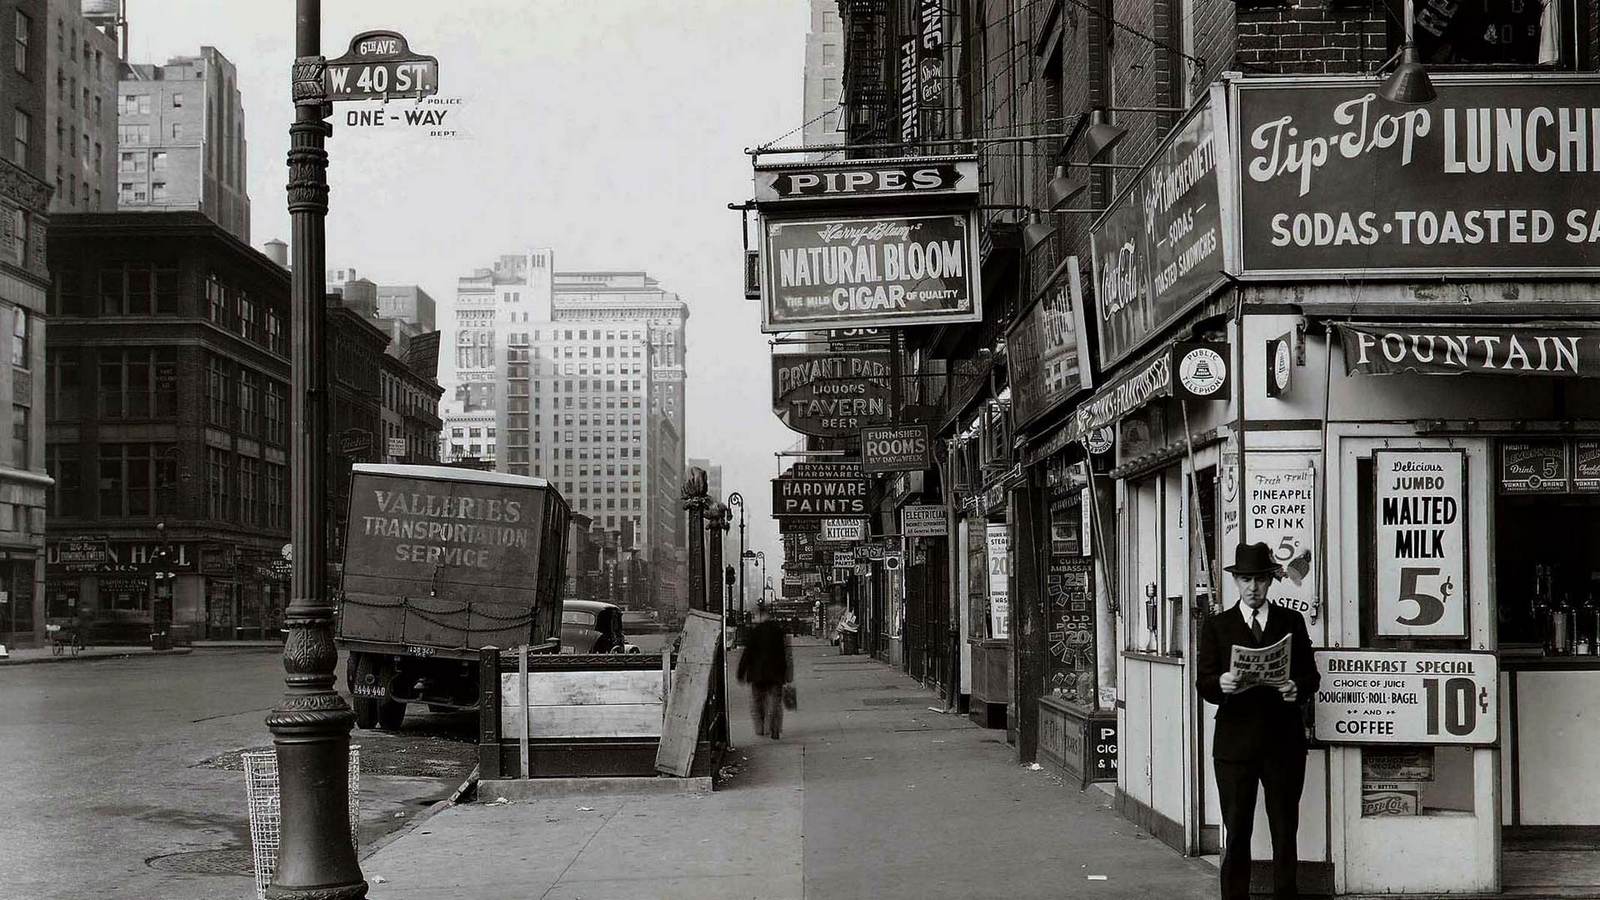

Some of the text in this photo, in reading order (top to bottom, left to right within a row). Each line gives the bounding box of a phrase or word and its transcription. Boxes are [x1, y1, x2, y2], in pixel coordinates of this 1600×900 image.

[360, 40, 399, 54] 6TH AVE.
[329, 64, 430, 93] W. 40 ST.
[901, 39, 918, 143] PRINTING
[788, 168, 942, 195] PIPES
[1169, 207, 1193, 247] SODAS
[1271, 211, 1379, 247] SODAS
[1395, 209, 1555, 245] TOASTED
[780, 239, 963, 287] NATURAL BLOOM
[785, 284, 958, 312] THE MILD CIGAR OF QUALITY
[1186, 349, 1219, 361] PUBLIC
[1354, 331, 1582, 375] FOUNTAIN
[778, 357, 846, 399] BRYANT
[1182, 376, 1224, 394] TELEPHONE
[812, 383, 865, 394] LIQUORS
[792, 398, 885, 417] TAVERN
[822, 418, 858, 429] BEER
[868, 429, 922, 441] FURNISHED
[866, 439, 926, 457] ROOMS
[882, 456, 896, 464] DAY
[1391, 461, 1444, 472] Delicious
[798, 464, 836, 472] BRYANT
[782, 482, 867, 497] HARDWARE
[1392, 476, 1445, 490] JUMBO
[1253, 489, 1312, 501] PINEAPPLE
[785, 499, 864, 512] PAINTS
[1252, 504, 1306, 515] OR GRAPE
[1382, 496, 1458, 526] MALTED
[1254, 518, 1305, 529] DRINK
[363, 516, 528, 549] TRANSPORTATION
[827, 527, 860, 538] KITCHEN
[1395, 529, 1445, 559] MILK
[396, 543, 490, 568] SERVICE
[1328, 659, 1475, 674] BREAKFAST SPECIAL
[1333, 679, 1405, 688] CHOICE OF JUICE
[1363, 708, 1382, 716] AND
[1100, 728, 1115, 740] P
[1335, 720, 1394, 735] COFFEE
[1096, 744, 1118, 754] CIG
[1098, 759, 1117, 768] & N
